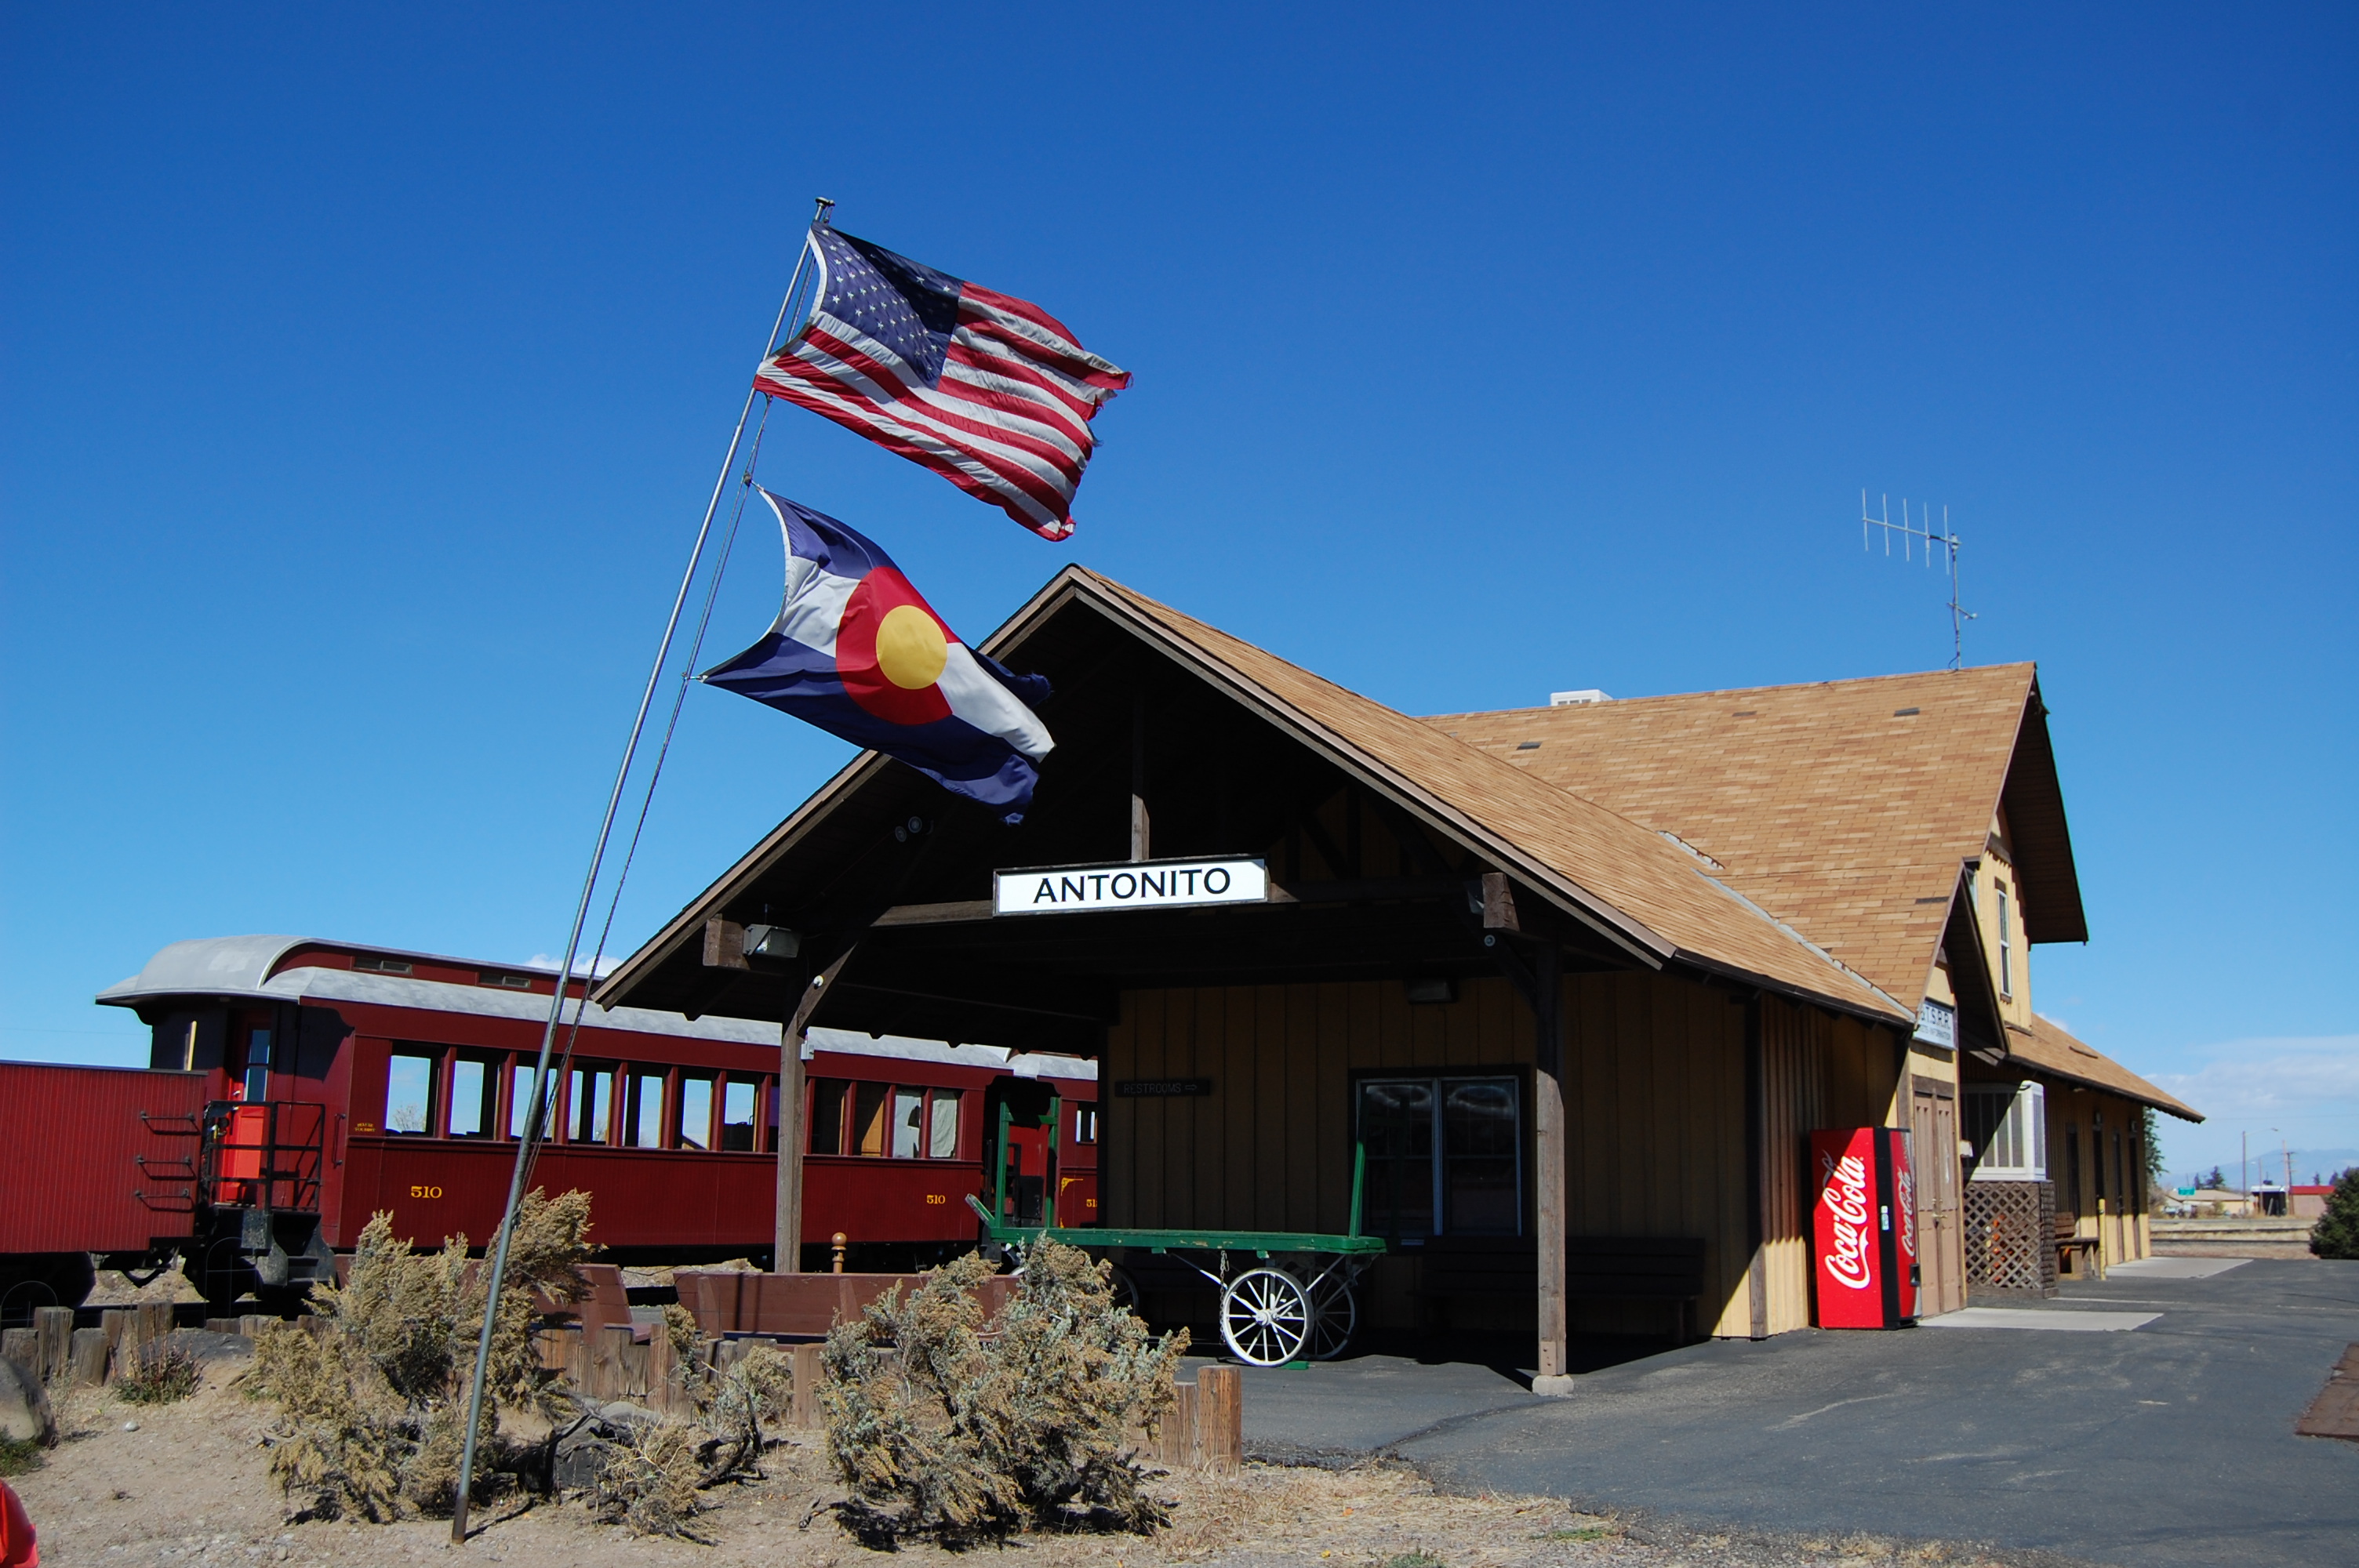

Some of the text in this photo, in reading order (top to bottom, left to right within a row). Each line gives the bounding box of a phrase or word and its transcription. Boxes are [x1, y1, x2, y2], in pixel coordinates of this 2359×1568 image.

[1033, 867, 1231, 904] ANTONITO
[1124, 1083, 1182, 1095] RESTROOMS
[410, 1185, 442, 1199] 510
[926, 1194, 946, 1204] 510
[1822, 1149, 1870, 1290] Coca-Cola
